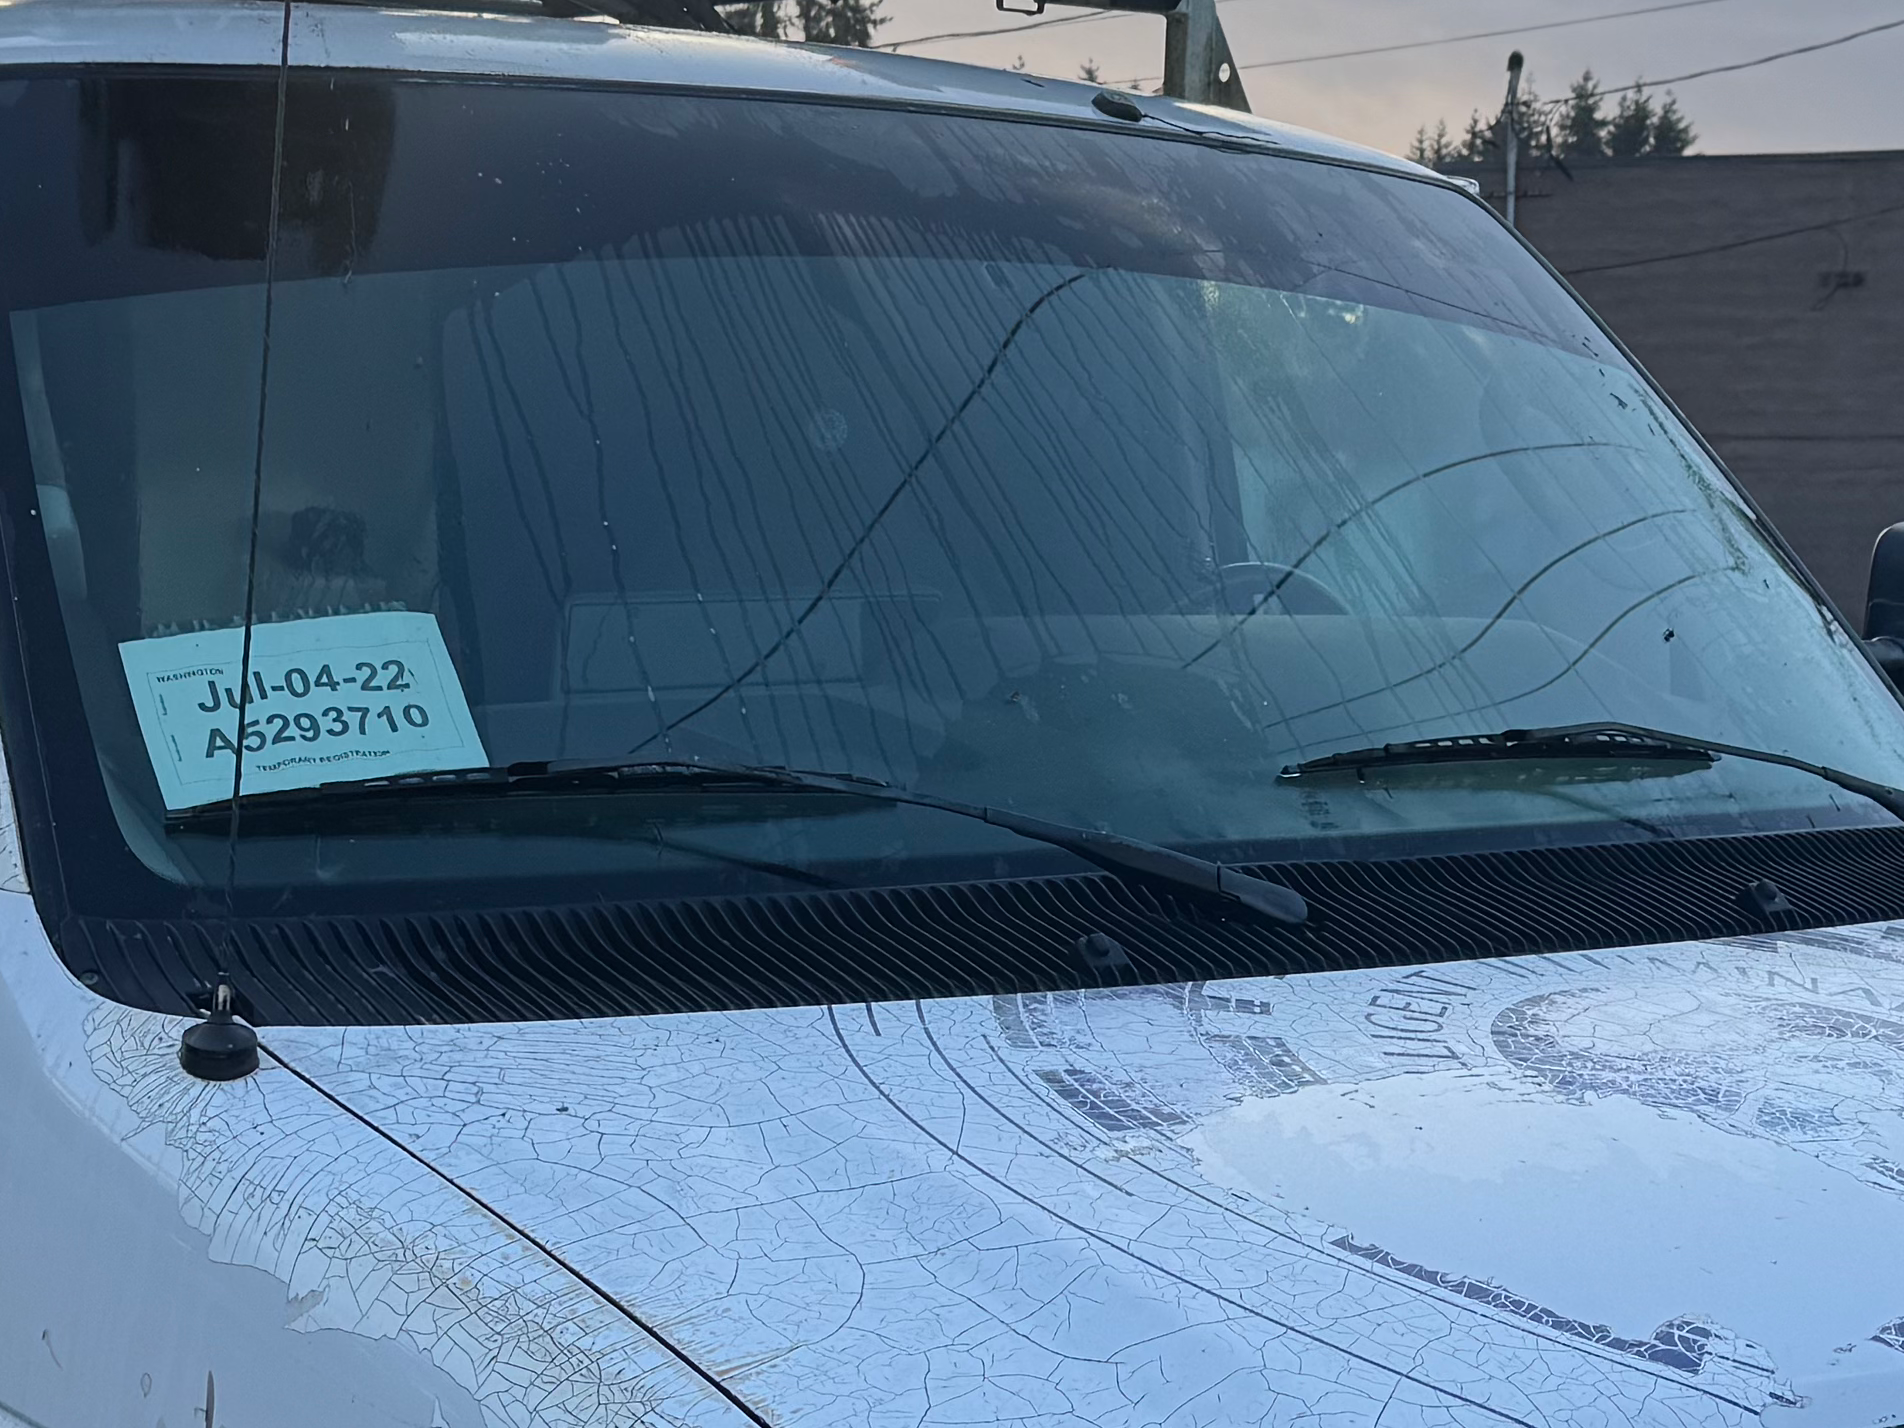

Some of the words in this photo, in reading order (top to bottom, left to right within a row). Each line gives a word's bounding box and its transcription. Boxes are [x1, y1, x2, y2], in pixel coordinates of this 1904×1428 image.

[156, 667, 224, 683] WASHINGTON
[197, 659, 412, 713] Jul-04-22
[204, 703, 431, 759] A5293710
[255, 756, 317, 772] TEMPORARY
[318, 749, 391, 765] REGISTRATION
